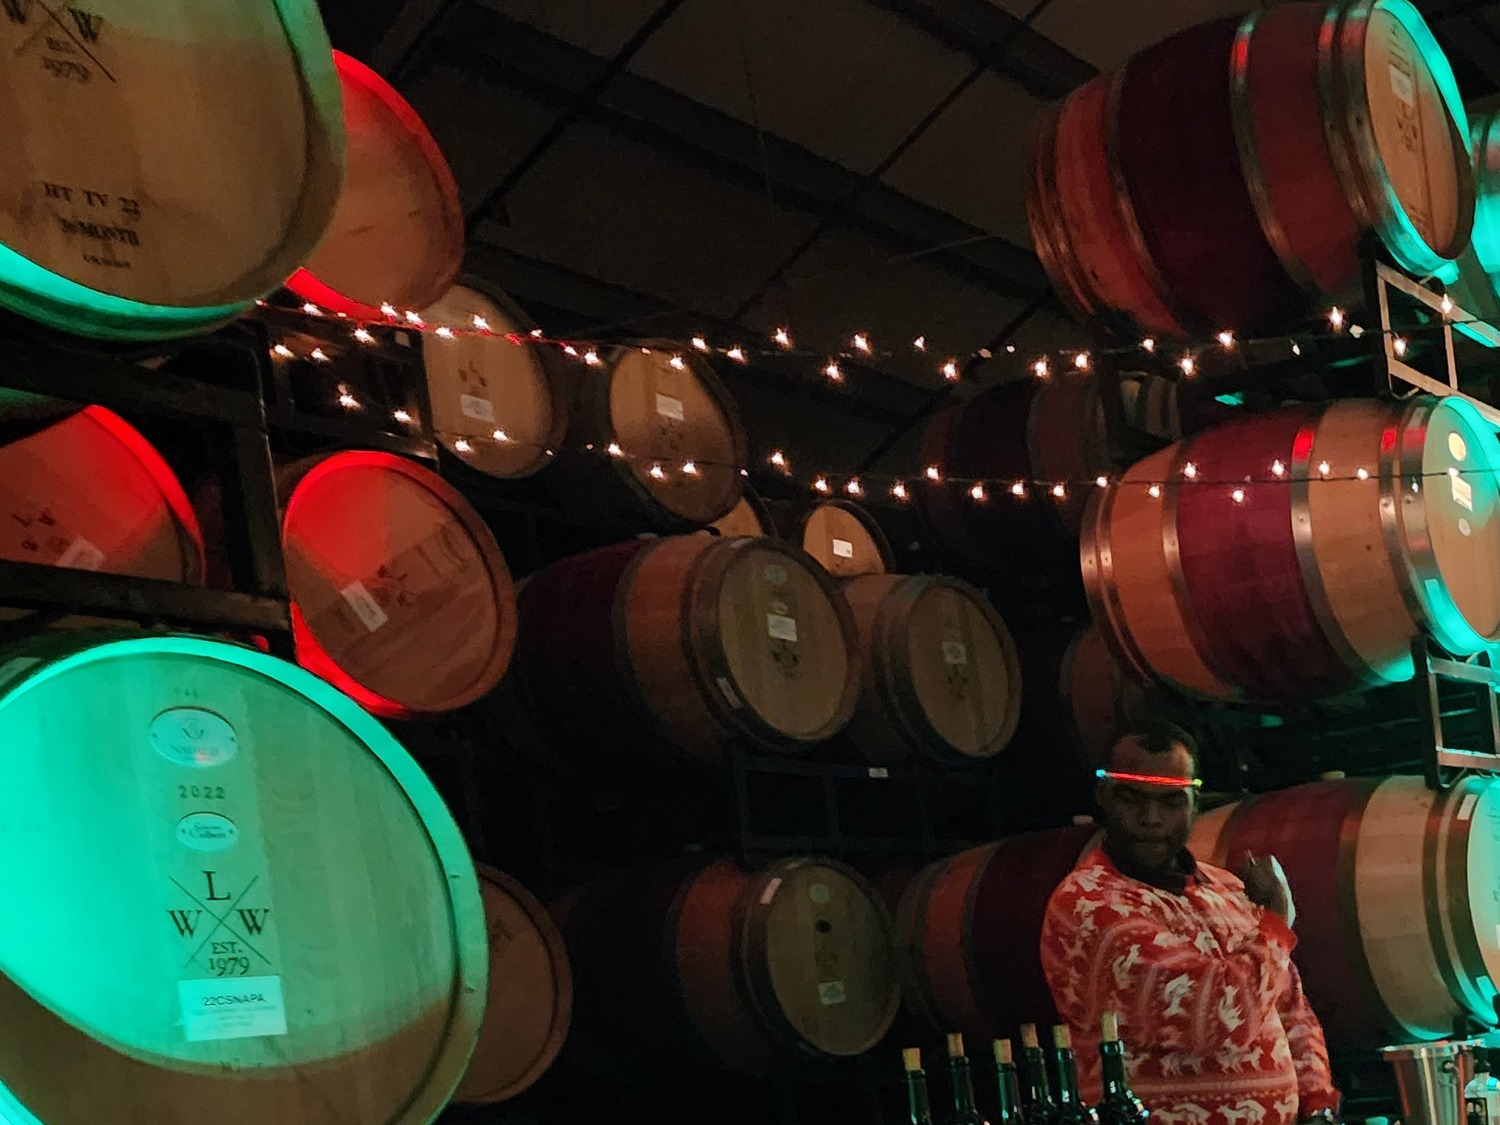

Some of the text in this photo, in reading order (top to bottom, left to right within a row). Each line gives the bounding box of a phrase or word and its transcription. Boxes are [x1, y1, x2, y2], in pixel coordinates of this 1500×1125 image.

[178, 784, 226, 800] 2022
[203, 870, 231, 901] L
[168, 908, 269, 938] W W
[211, 942, 243, 954] EST.
[208, 956, 250, 977] 1979
[203, 993, 265, 1007] 22CSNAPA
